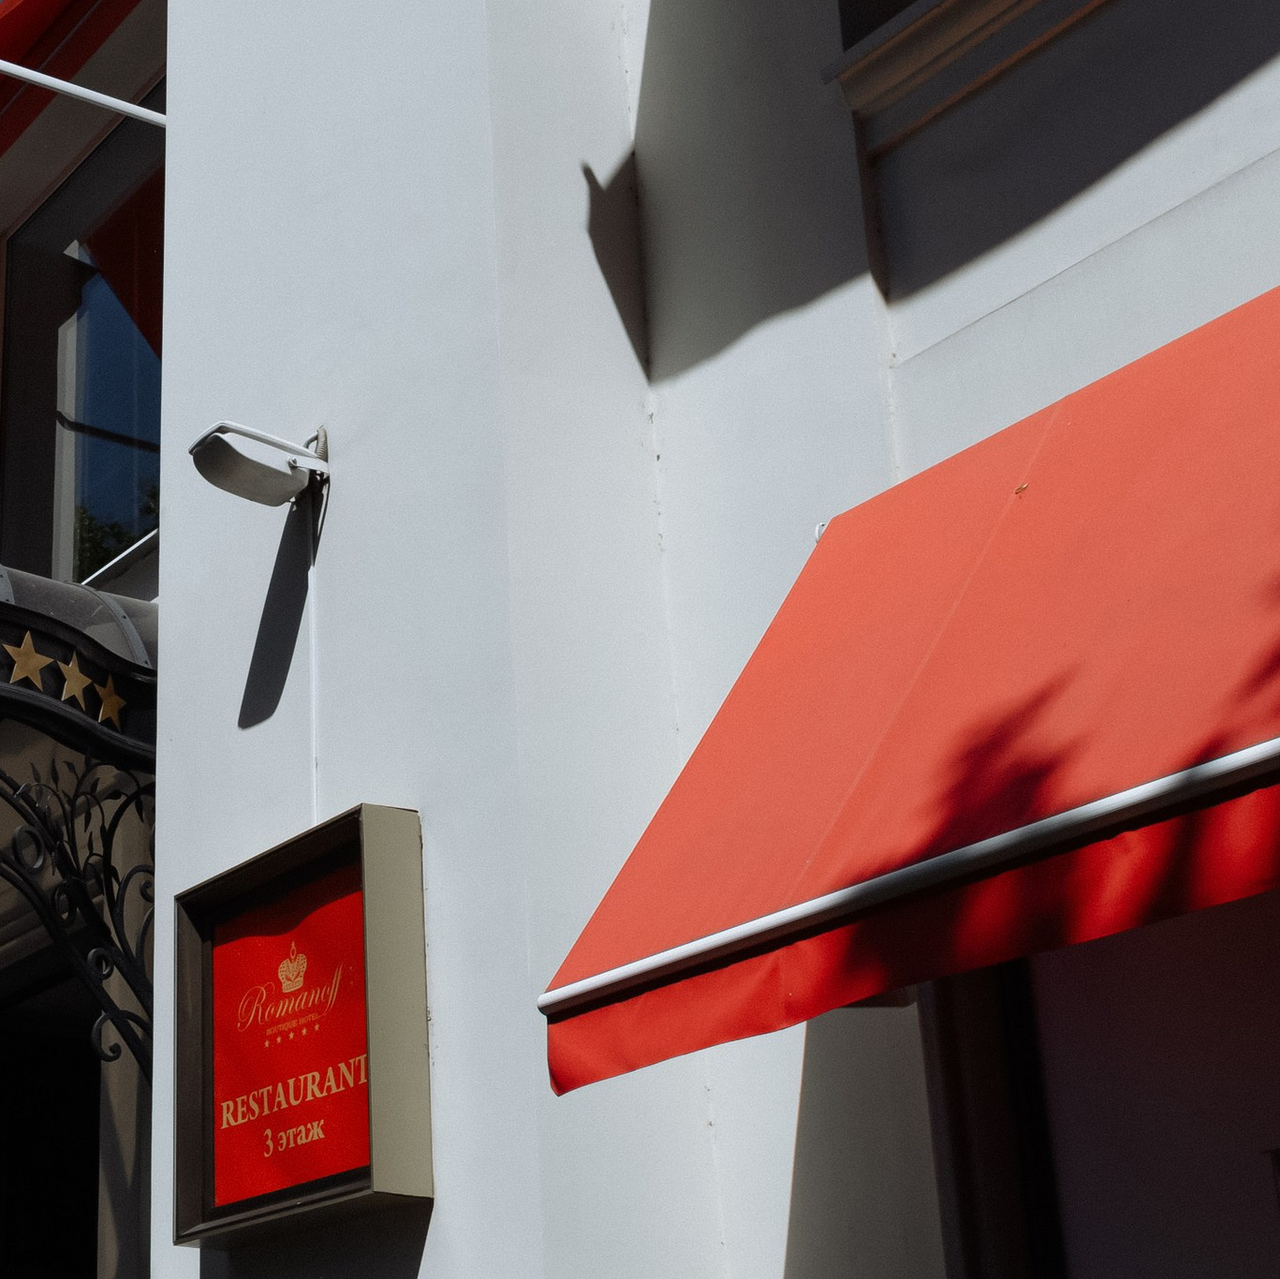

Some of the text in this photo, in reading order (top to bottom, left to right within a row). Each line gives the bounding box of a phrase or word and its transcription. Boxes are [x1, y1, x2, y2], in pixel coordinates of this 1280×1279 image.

[237, 962, 343, 1031] Romanoff
[299, 1012, 320, 1025] HOTEL
[221, 1054, 368, 1128] RESTAURANT
[263, 1117, 325, 1157] 3 этаж
